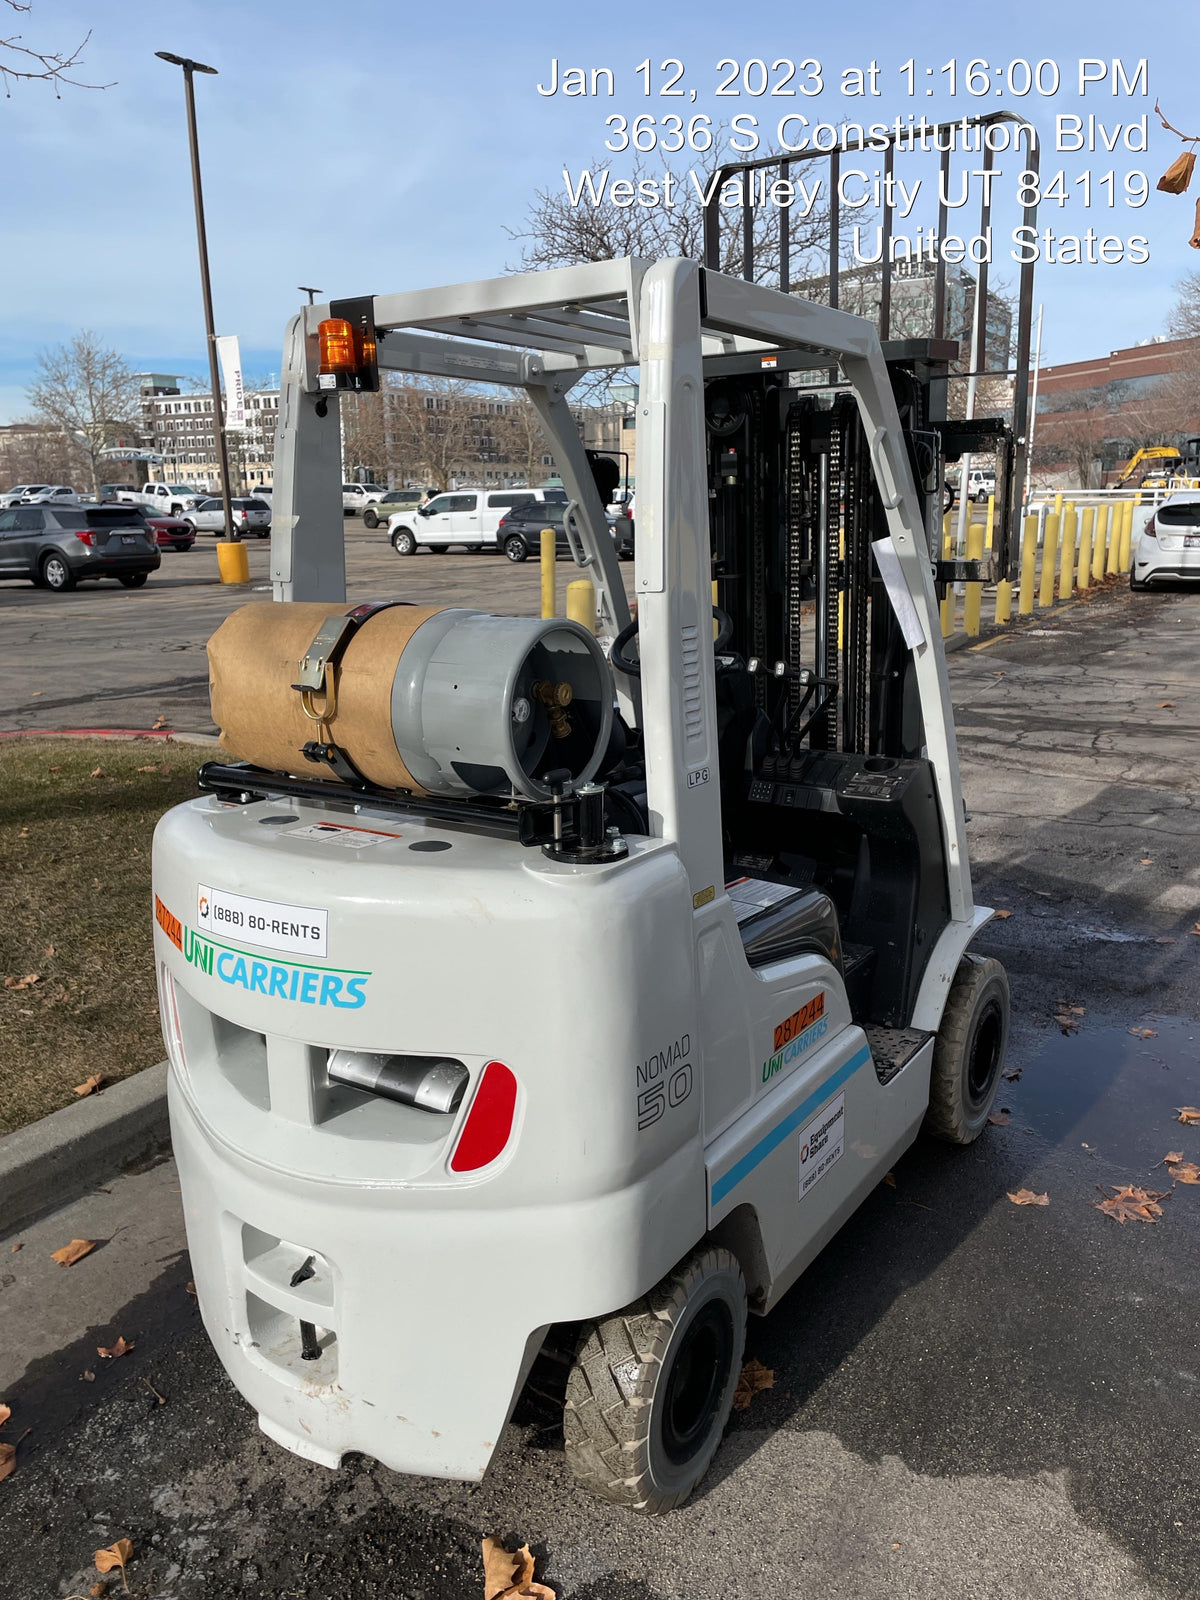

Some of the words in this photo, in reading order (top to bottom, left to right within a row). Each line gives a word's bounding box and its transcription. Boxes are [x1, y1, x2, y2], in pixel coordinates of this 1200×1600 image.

[234, 370, 243, 409] PRIDE
[689, 769, 708, 786] LPG
[213, 904, 244, 927] (888)
[248, 915, 321, 940] 80-RENTS
[774, 993, 824, 1051] 287244
[636, 1033, 691, 1088] NOMAD
[637, 1063, 693, 1131] 50
[809, 1106, 844, 1146] Equipment
[809, 1135, 829, 1159] Share
